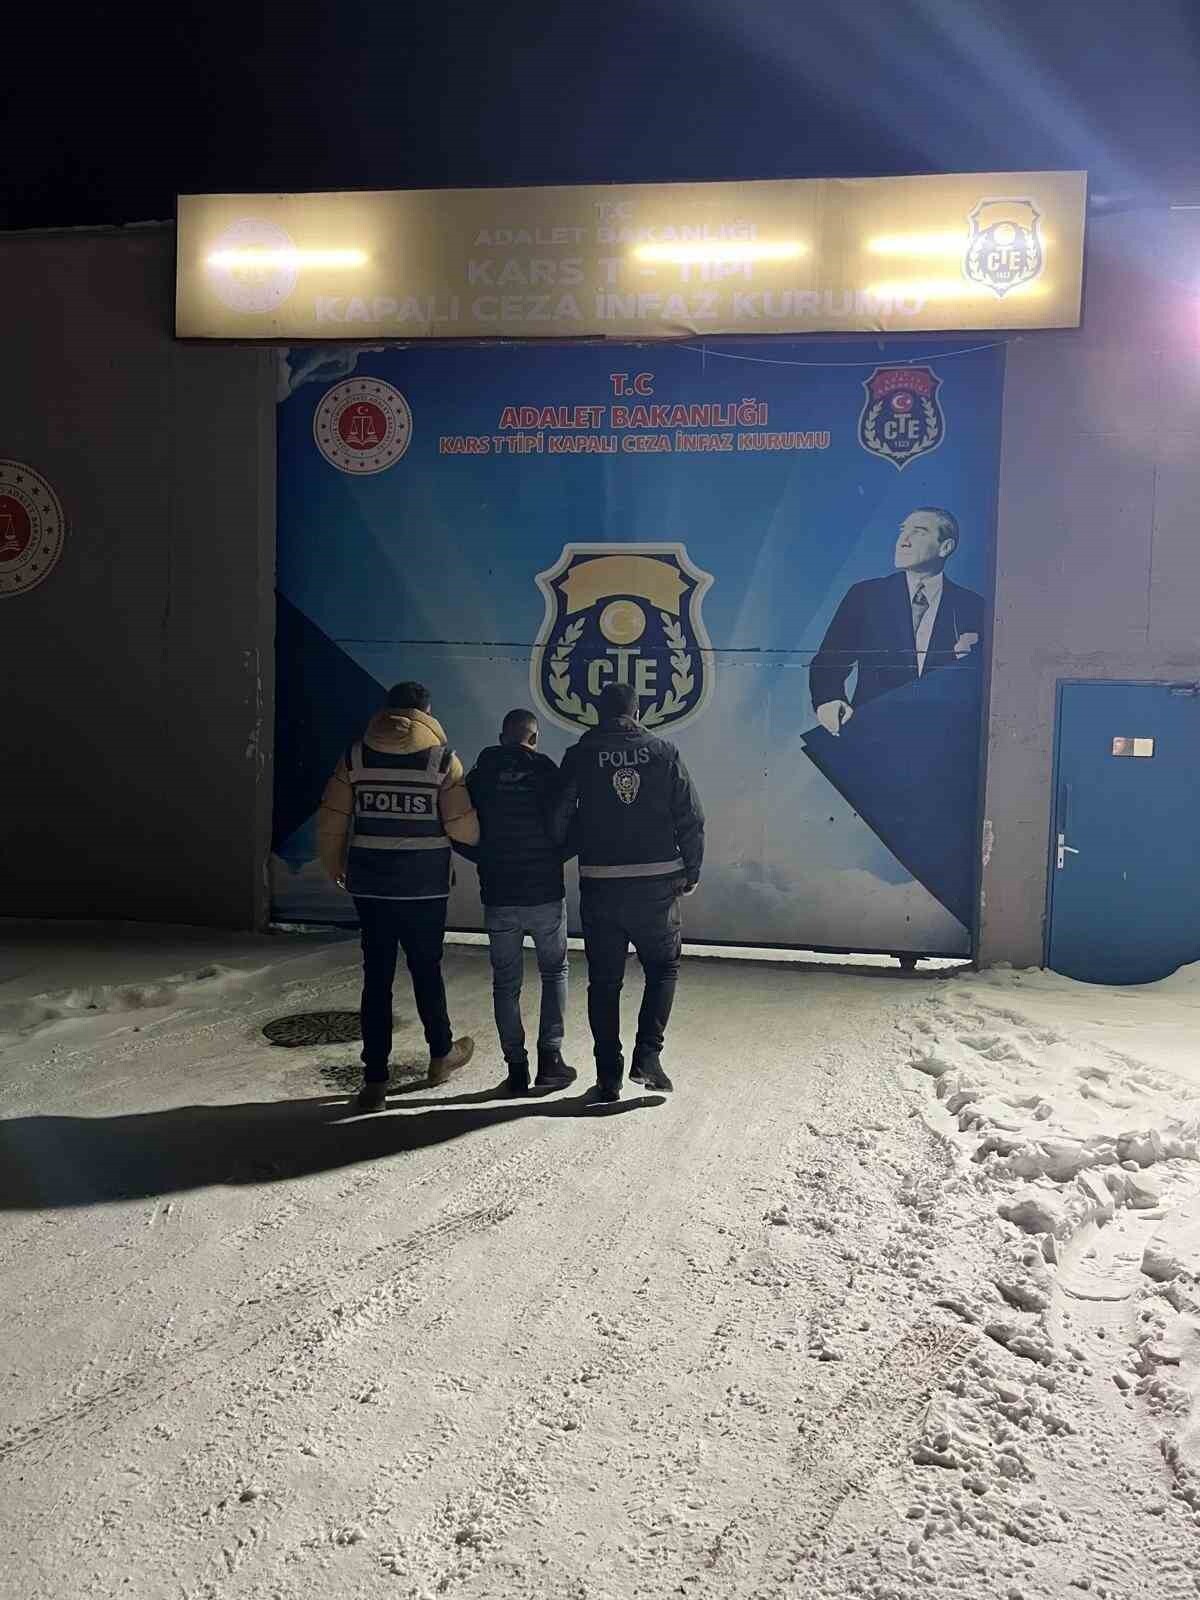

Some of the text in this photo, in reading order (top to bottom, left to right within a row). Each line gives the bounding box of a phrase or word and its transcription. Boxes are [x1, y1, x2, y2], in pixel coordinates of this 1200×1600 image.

[475, 228, 588, 248] ADALET
[467, 258, 586, 286] KARS
[986, 247, 1021, 271] CTE
[315, 297, 460, 323] KAPALI
[472, 297, 584, 321] CEZA
[610, 372, 654, 396] T.C
[499, 398, 769, 429] ADALET BAKANLIĞI
[885, 414, 921, 440] CTE
[439, 435, 490, 454] KARS
[548, 435, 618, 453] KAPALI
[622, 434, 671, 453] CEZA
[675, 430, 733, 452] İNFAZ
[737, 430, 831, 451] KURUMU
[587, 648, 658, 697] CTE
